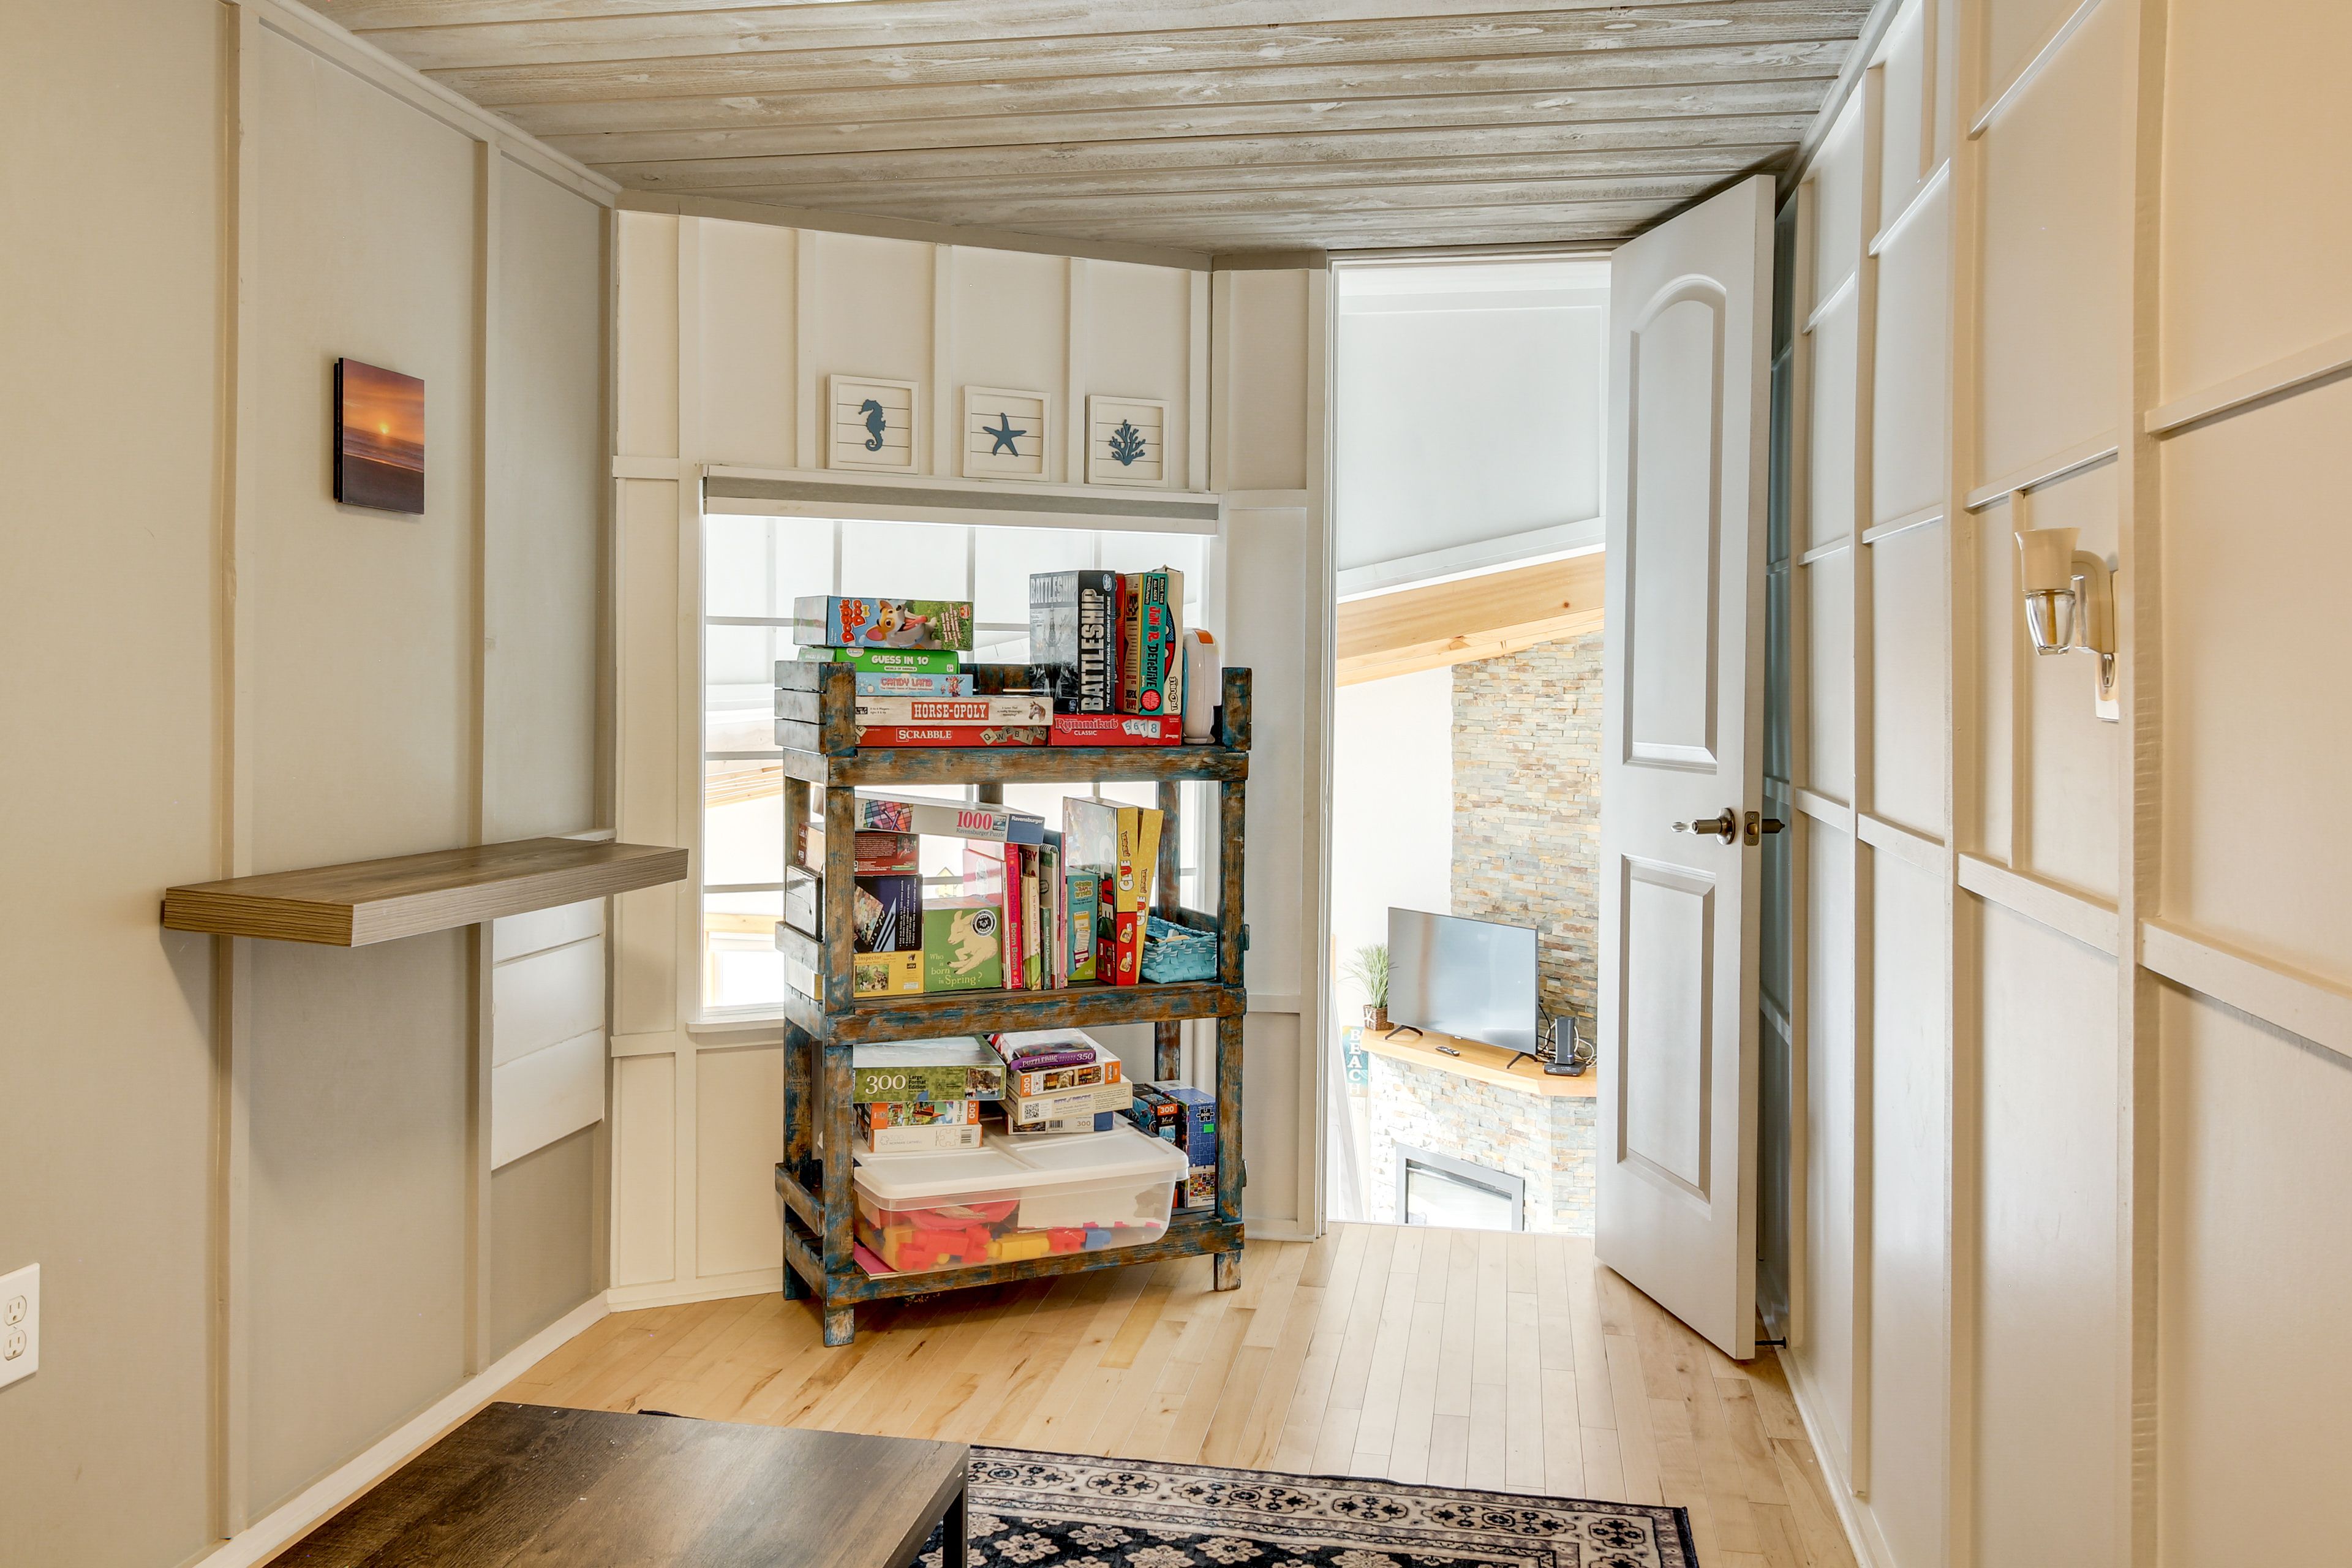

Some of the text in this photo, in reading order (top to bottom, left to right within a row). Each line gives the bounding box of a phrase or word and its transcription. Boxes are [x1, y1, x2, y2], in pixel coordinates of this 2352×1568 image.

[1030, 575, 1077, 604] BATTLESHIP
[853, 600, 865, 627] Doo
[1081, 589, 1104, 711] BATTLESHIP
[871, 655, 929, 665] GUESS IN 10
[880, 677, 933, 687] CANDY LAND
[1169, 676, 1178, 712] TROUBLE
[914, 704, 986, 718] HORSE-OPOLY
[1055, 718, 1118, 733] Rummikub
[1151, 723, 1157, 733] 8
[898, 729, 952, 740] SCRABBLE
[957, 811, 992, 831] 1000
[1011, 815, 1043, 824] Ravensburger
[956, 827, 989, 837] Ravensburger
[1119, 831, 1134, 892] CLUE JUNIOR
[1136, 896, 1146, 926] CLUE
[865, 1074, 906, 1095] 300
